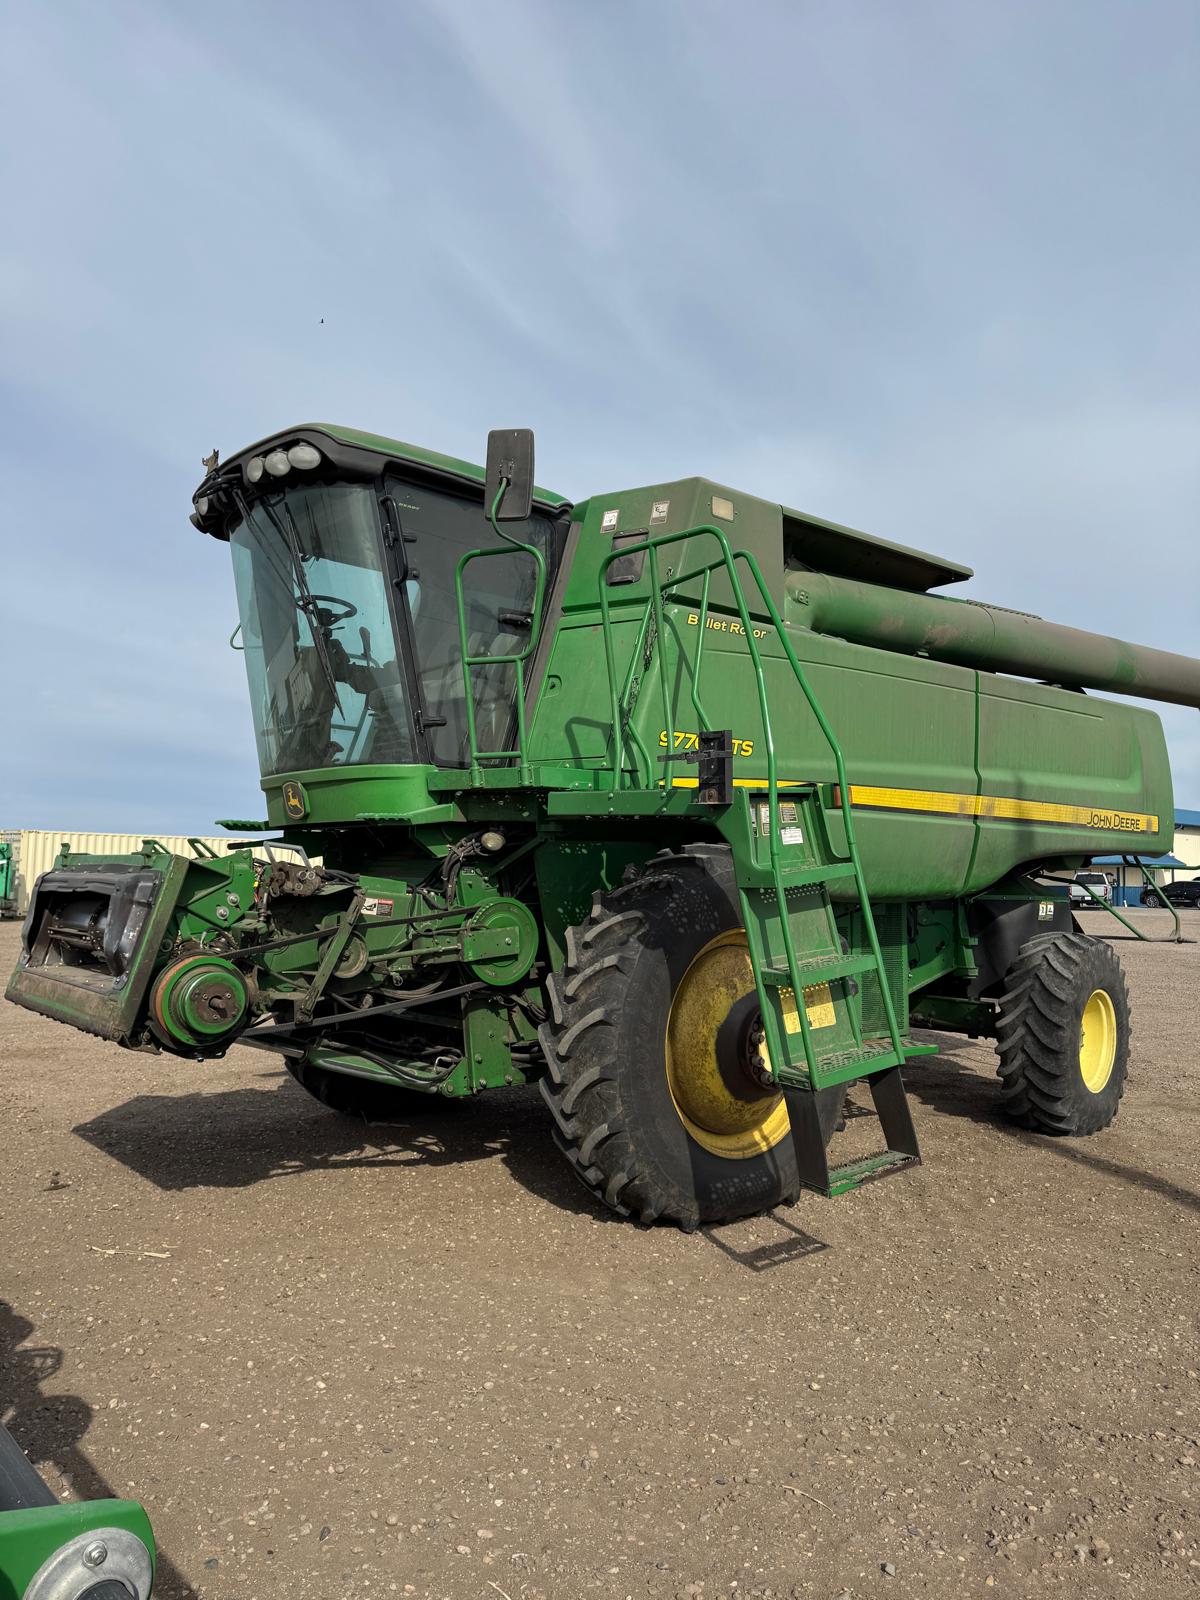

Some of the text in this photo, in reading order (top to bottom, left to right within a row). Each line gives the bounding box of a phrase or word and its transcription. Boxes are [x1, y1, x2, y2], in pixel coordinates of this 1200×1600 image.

[687, 613, 767, 639] Bllet Roor
[732, 739, 754, 757] TS
[1086, 811, 1141, 830] JOHN DEERE
